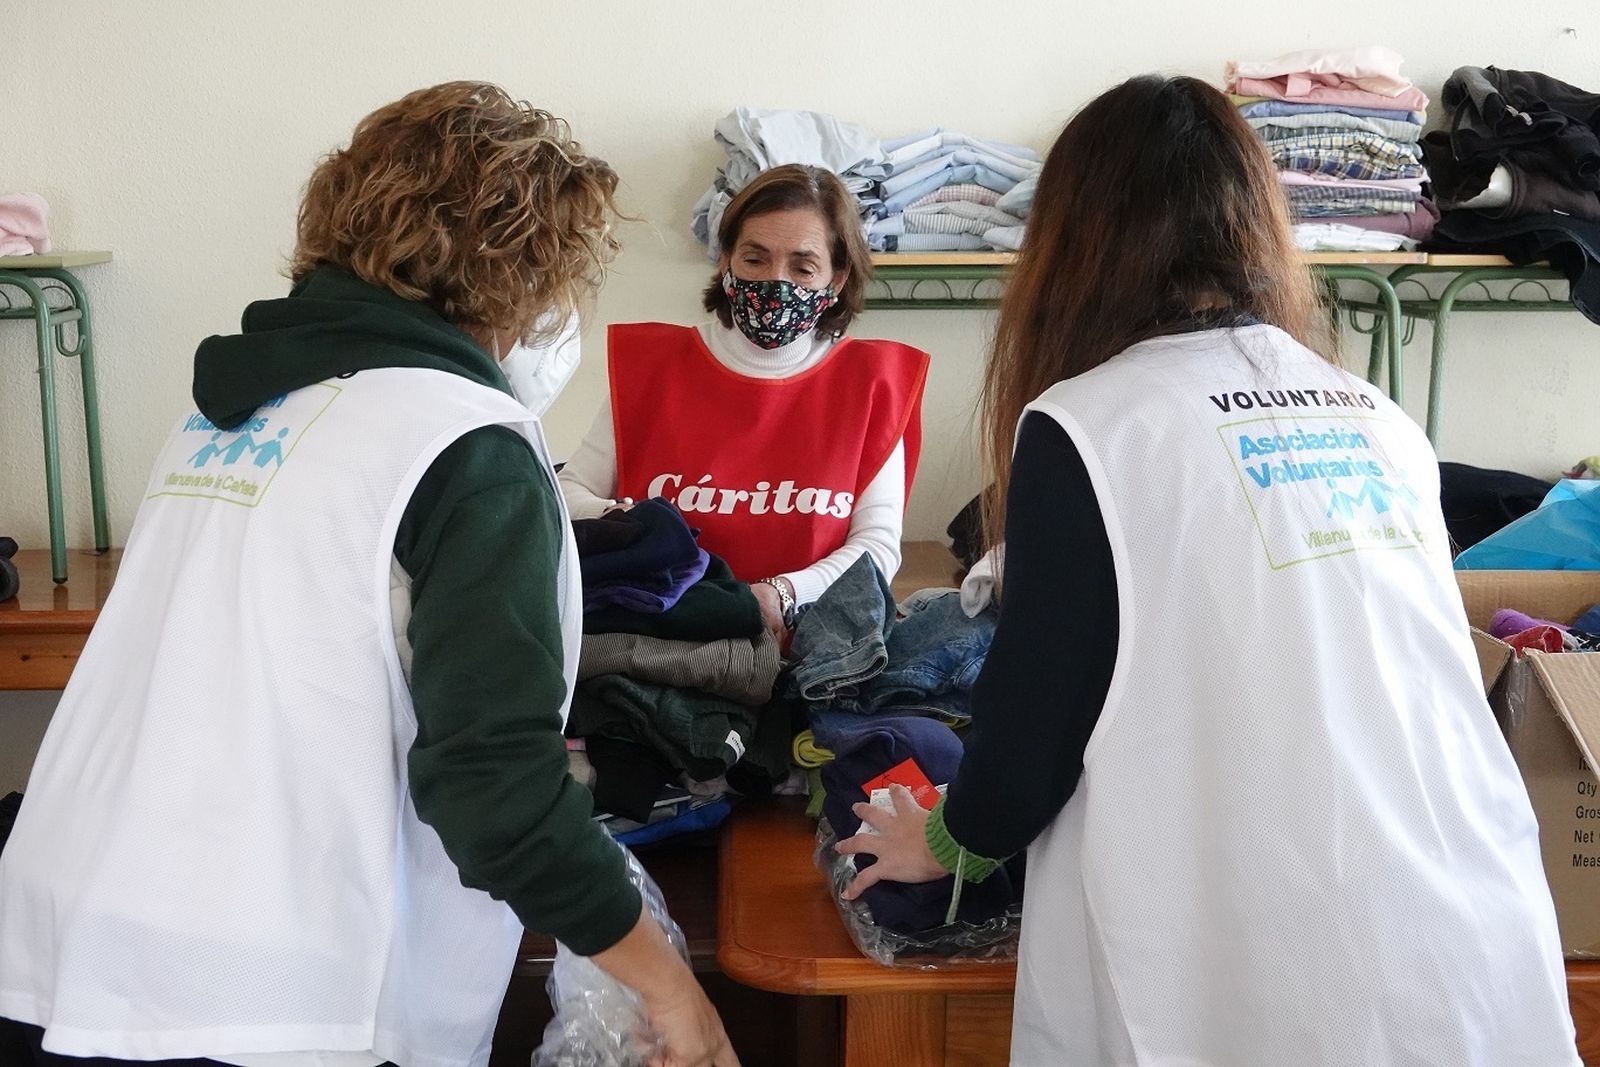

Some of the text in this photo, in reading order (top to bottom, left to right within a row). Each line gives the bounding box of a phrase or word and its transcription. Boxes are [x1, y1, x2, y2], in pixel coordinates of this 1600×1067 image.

[1209, 388, 1377, 413] VOLUNTARIO
[1238, 427, 1370, 460] Asociación
[647, 473, 855, 518] Cáritas
[1302, 528, 1356, 549] Villanu
[1577, 781, 1597, 798] Qty
[1574, 829, 1594, 843] Net
